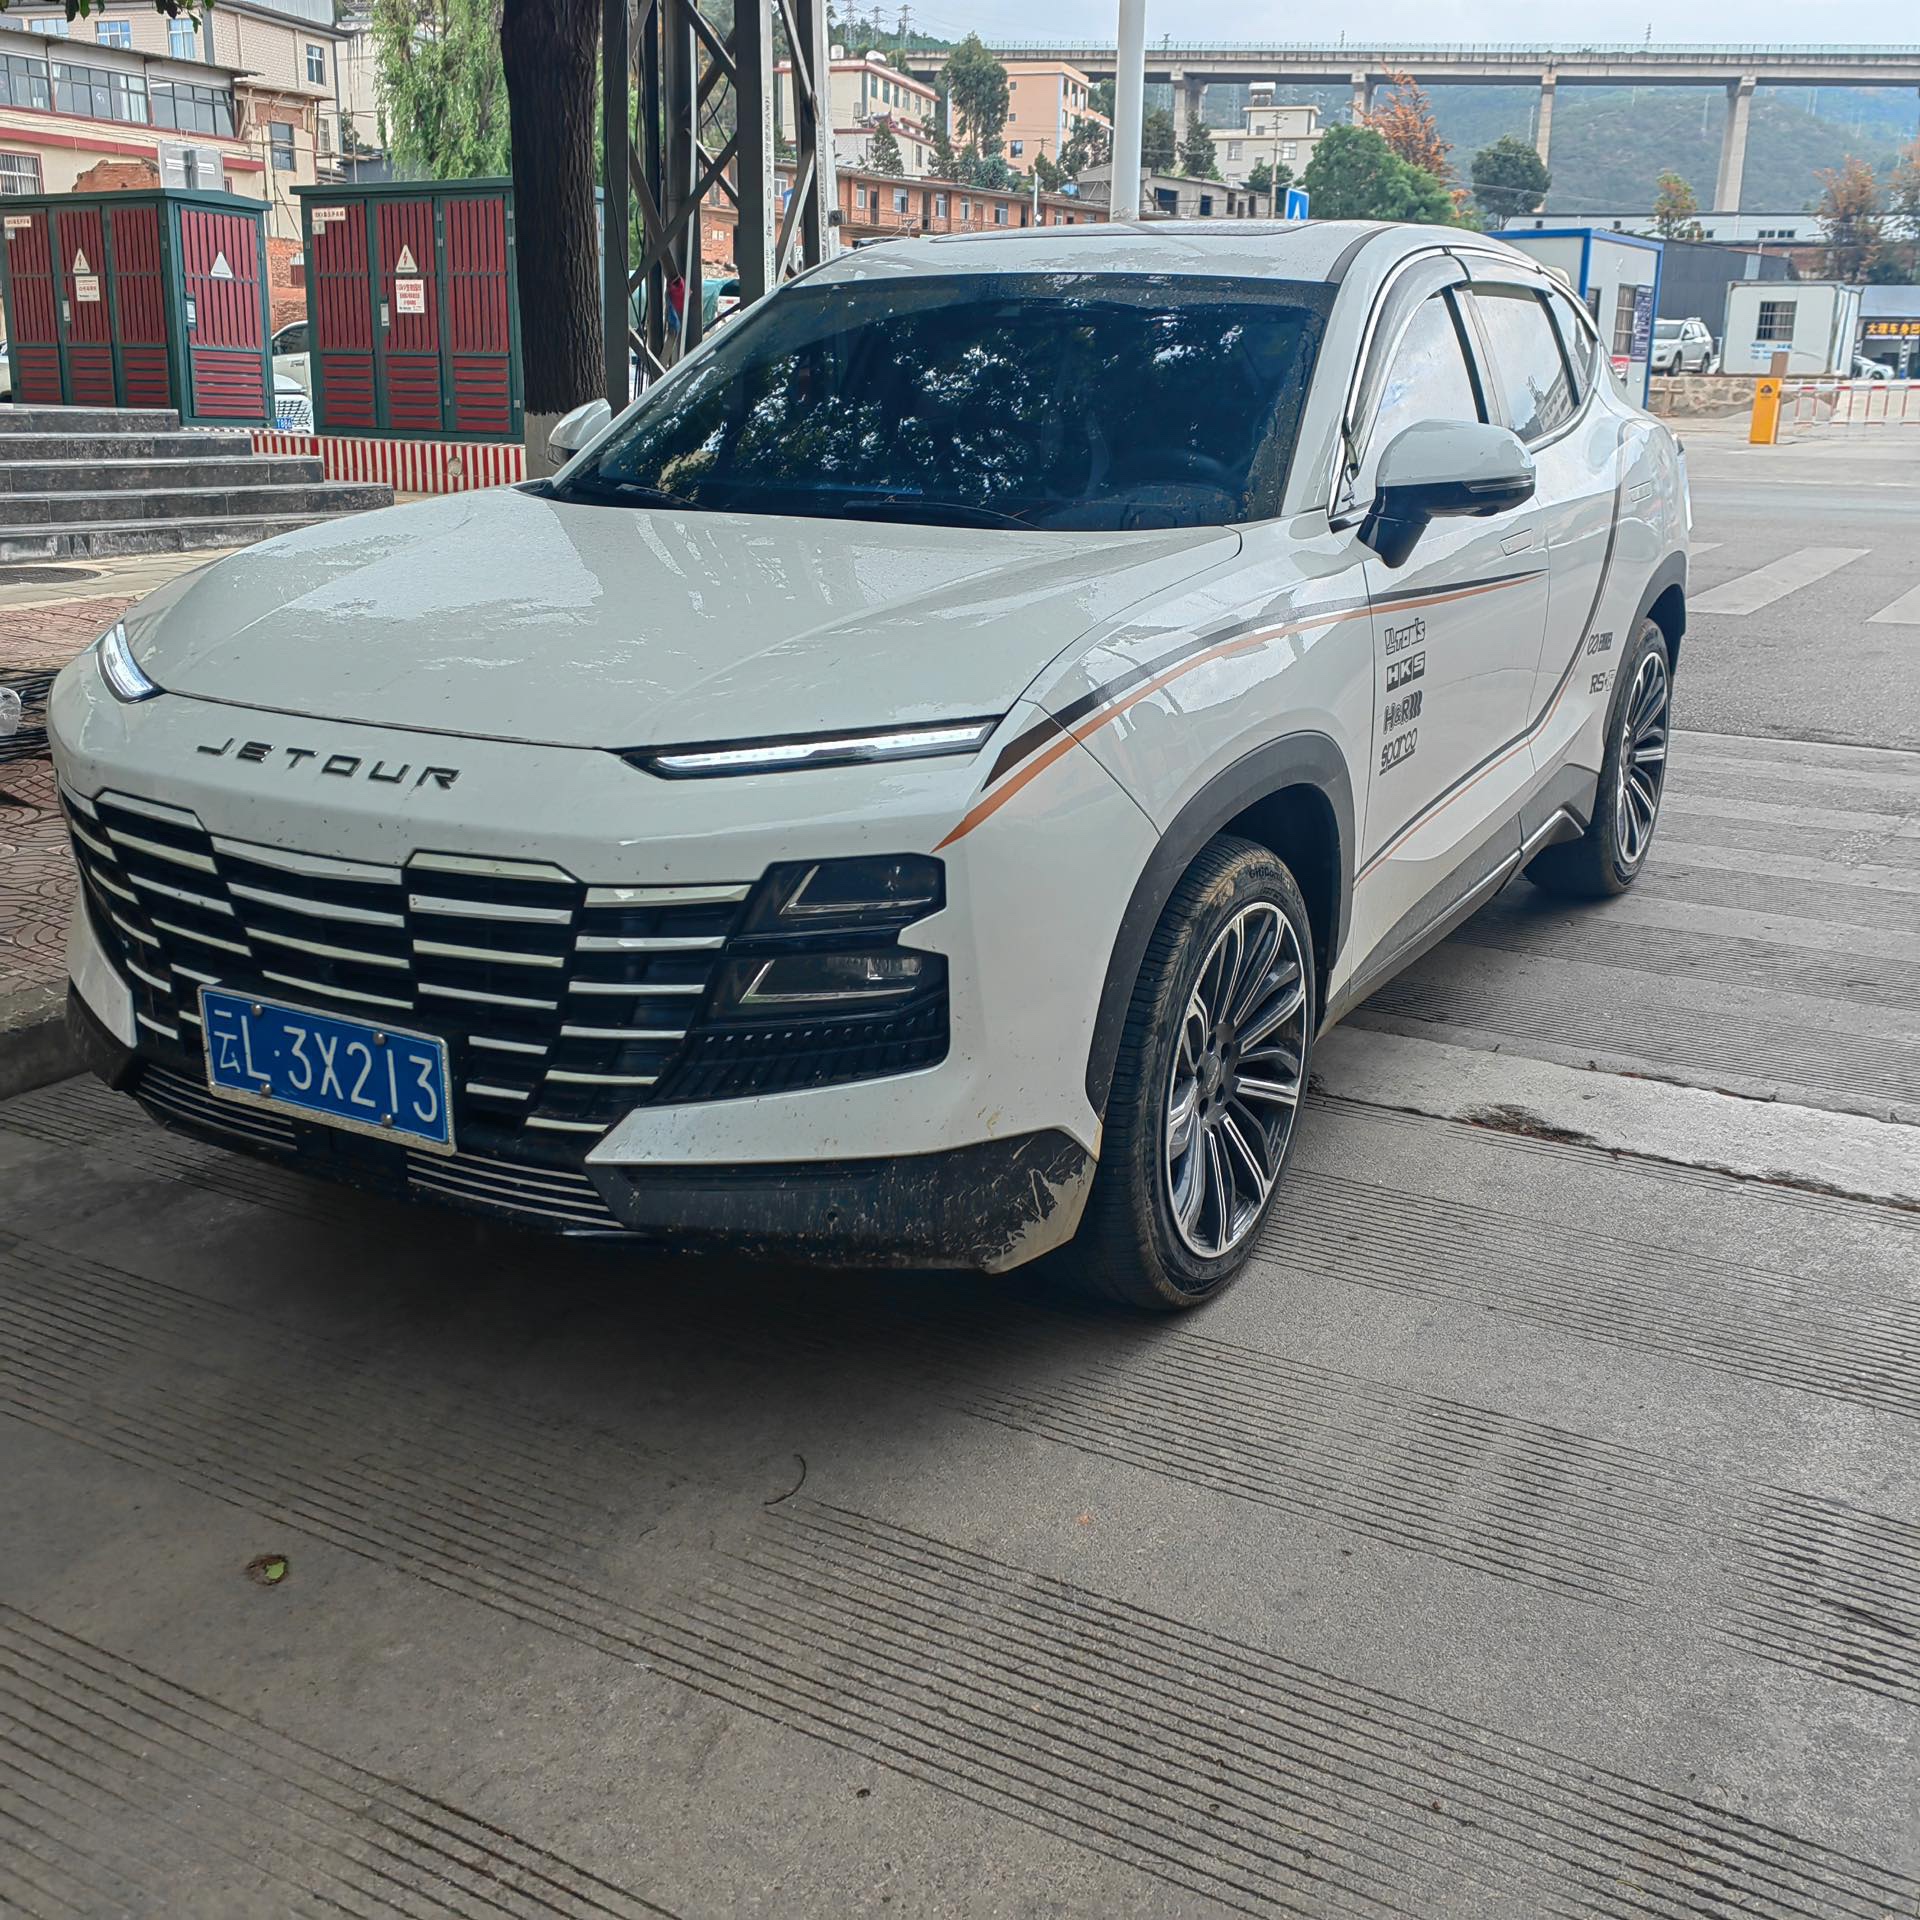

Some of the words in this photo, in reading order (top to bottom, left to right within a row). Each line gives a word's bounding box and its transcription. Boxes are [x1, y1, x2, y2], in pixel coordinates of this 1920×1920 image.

[1387, 651, 1425, 690] HKS
[197, 737, 462, 790] JETOUR
[1381, 727, 1418, 771] sparco
